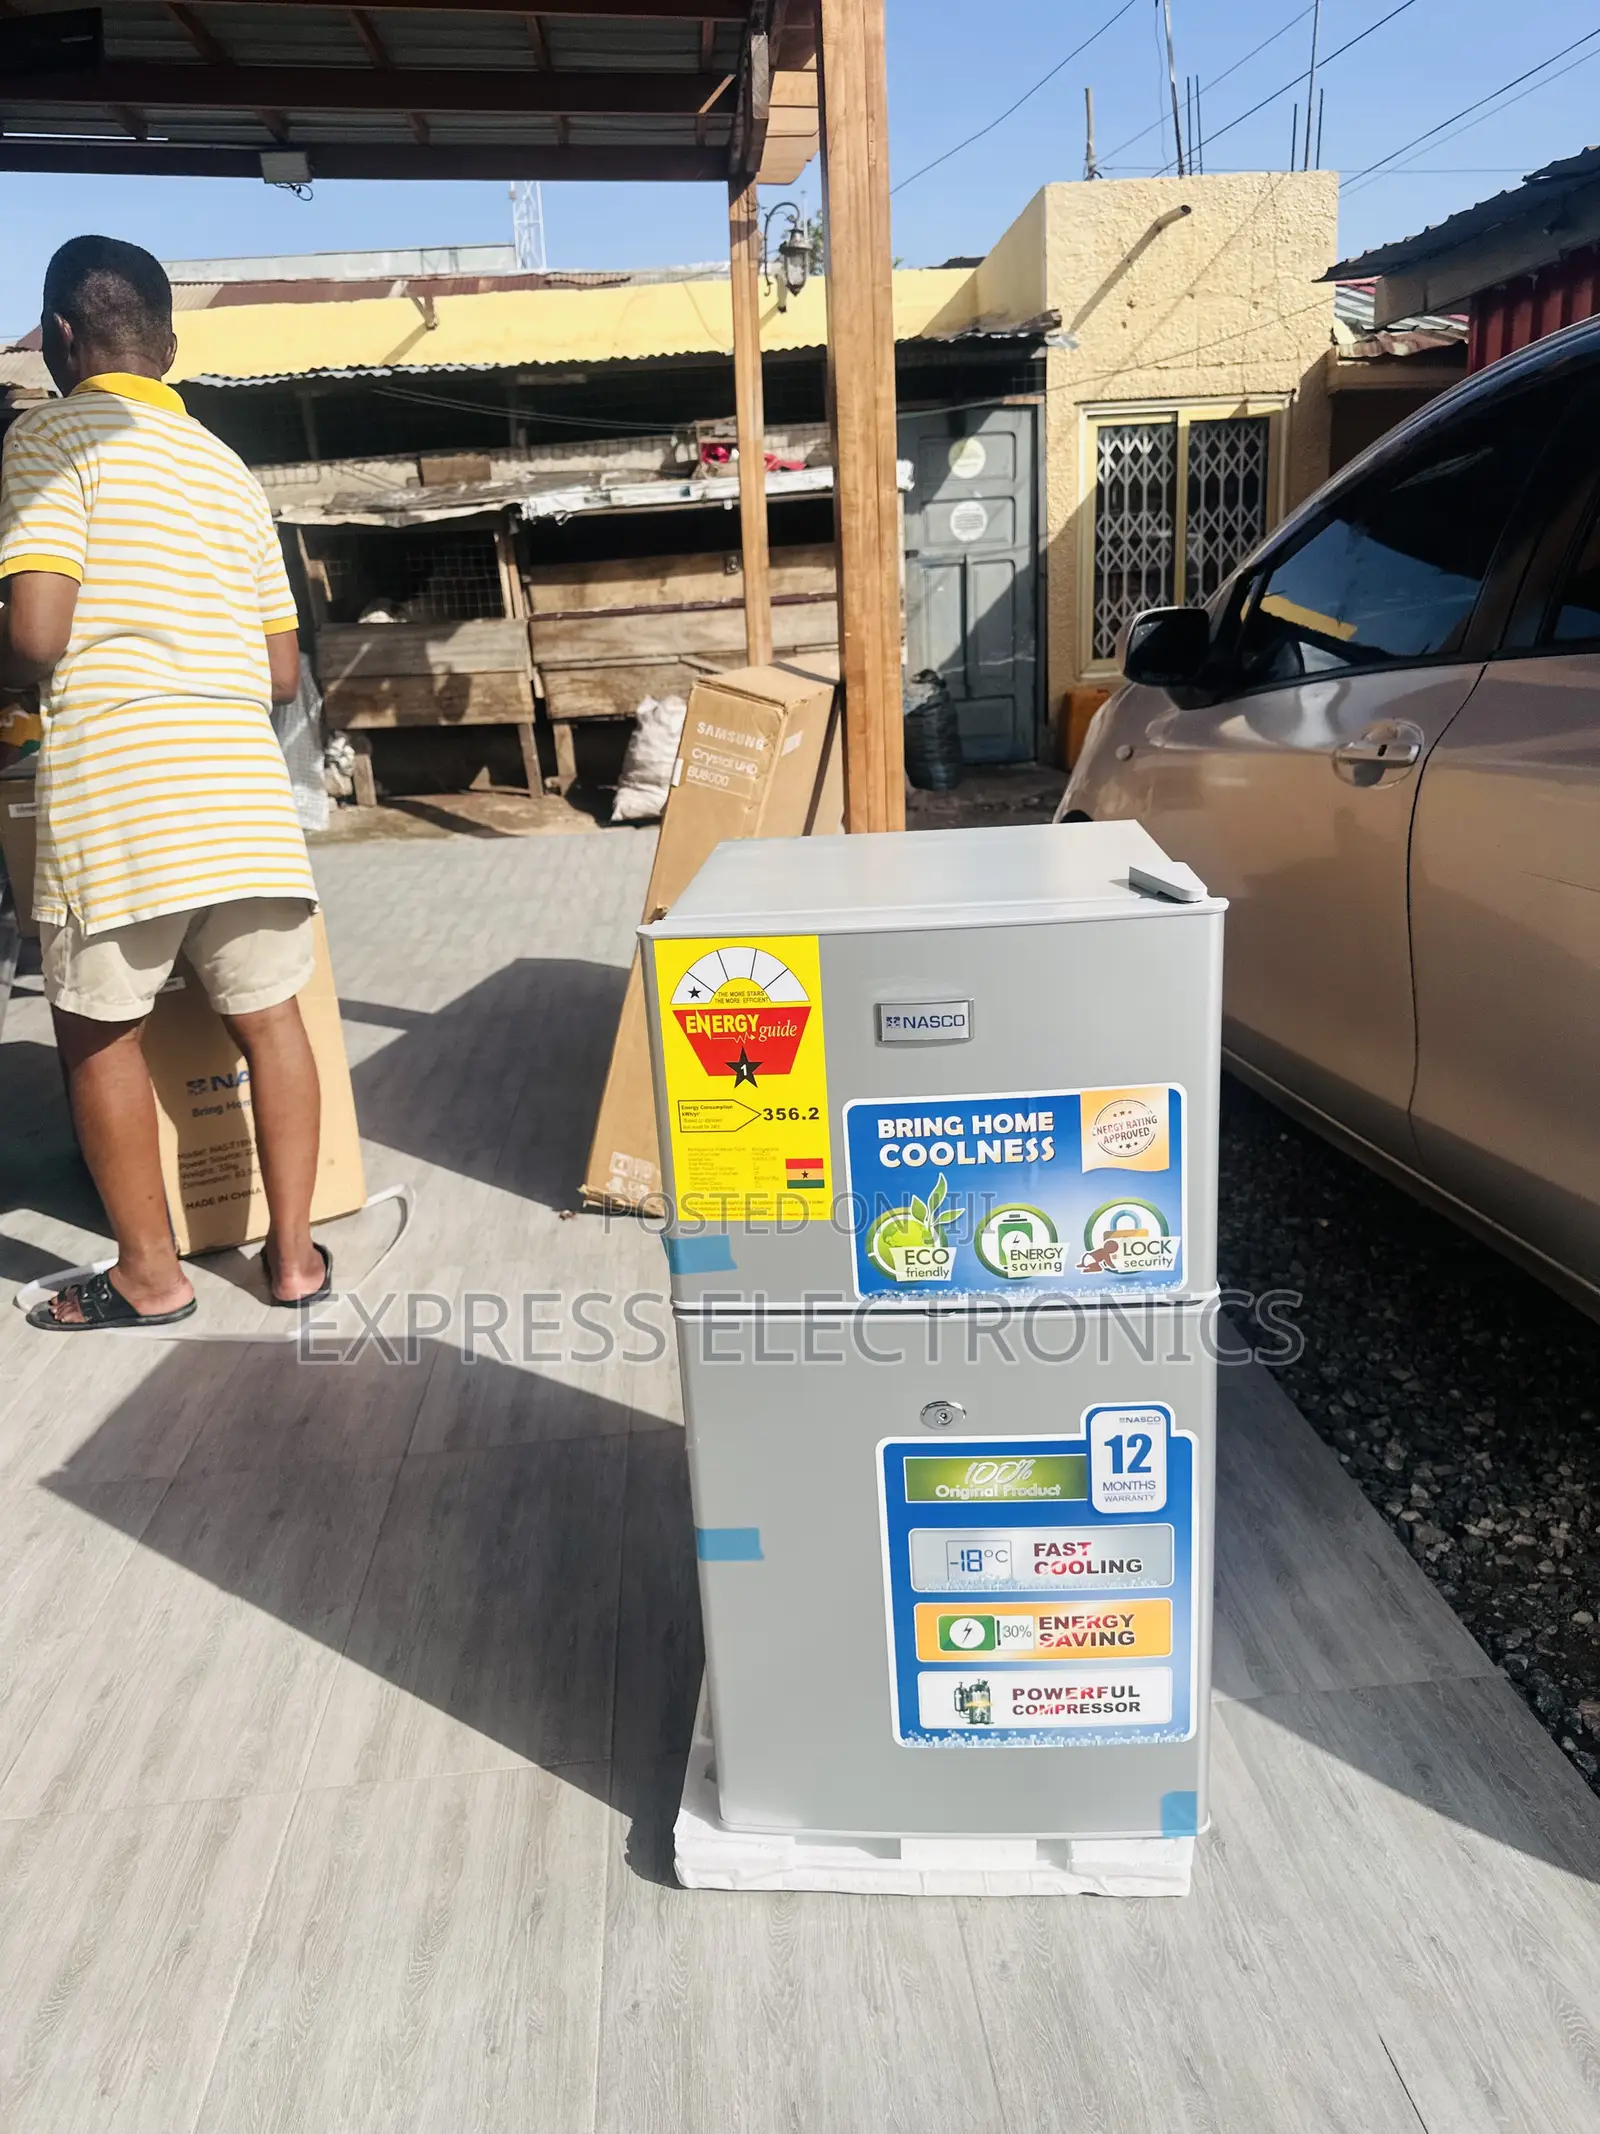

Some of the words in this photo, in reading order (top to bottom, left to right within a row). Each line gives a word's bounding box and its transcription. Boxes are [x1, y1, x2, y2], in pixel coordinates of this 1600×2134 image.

[697, 721, 765, 751] SAMSUNG
[685, 1010, 760, 1040] ENERGY
[759, 1020, 797, 1042] guide
[903, 1014, 965, 1029] NASCO
[740, 1063, 748, 1076] 1
[762, 1106, 820, 1121] 356.2
[877, 1117, 965, 1139] BRING
[972, 1111, 1055, 1135] HOME
[1103, 1126, 1150, 1144] APPROVED
[879, 1136, 1056, 1168] COOLNESS
[218, 1194, 228, 1203] IN
[230, 1187, 262, 1200] CHINA
[905, 1248, 949, 1265] ECO
[1011, 1247, 1063, 1261] ENERGY
[1123, 1240, 1172, 1257] LOCK
[1012, 1260, 1062, 1273] saving
[1124, 1255, 1173, 1269] security
[906, 1265, 949, 1280] friendly
[1125, 1416, 1161, 1424] NASCO
[1104, 1433, 1152, 1474] 12
[965, 1458, 1036, 1485] 100%
[935, 1483, 998, 1501] Original
[1003, 1484, 1061, 1498] Product
[1102, 1480, 1156, 1492] MONTHS
[1104, 1494, 1156, 1503] WARRANTY
[1033, 1541, 1092, 1557] FAST
[1033, 1558, 1142, 1576] COOLING
[1038, 1613, 1135, 1630] ENERGY
[1003, 1624, 1033, 1639] 30%
[1038, 1630, 1135, 1648] SAVING
[1012, 1685, 1141, 1701] POWERFUL
[1012, 1701, 1141, 1716] COMPRESSOR
